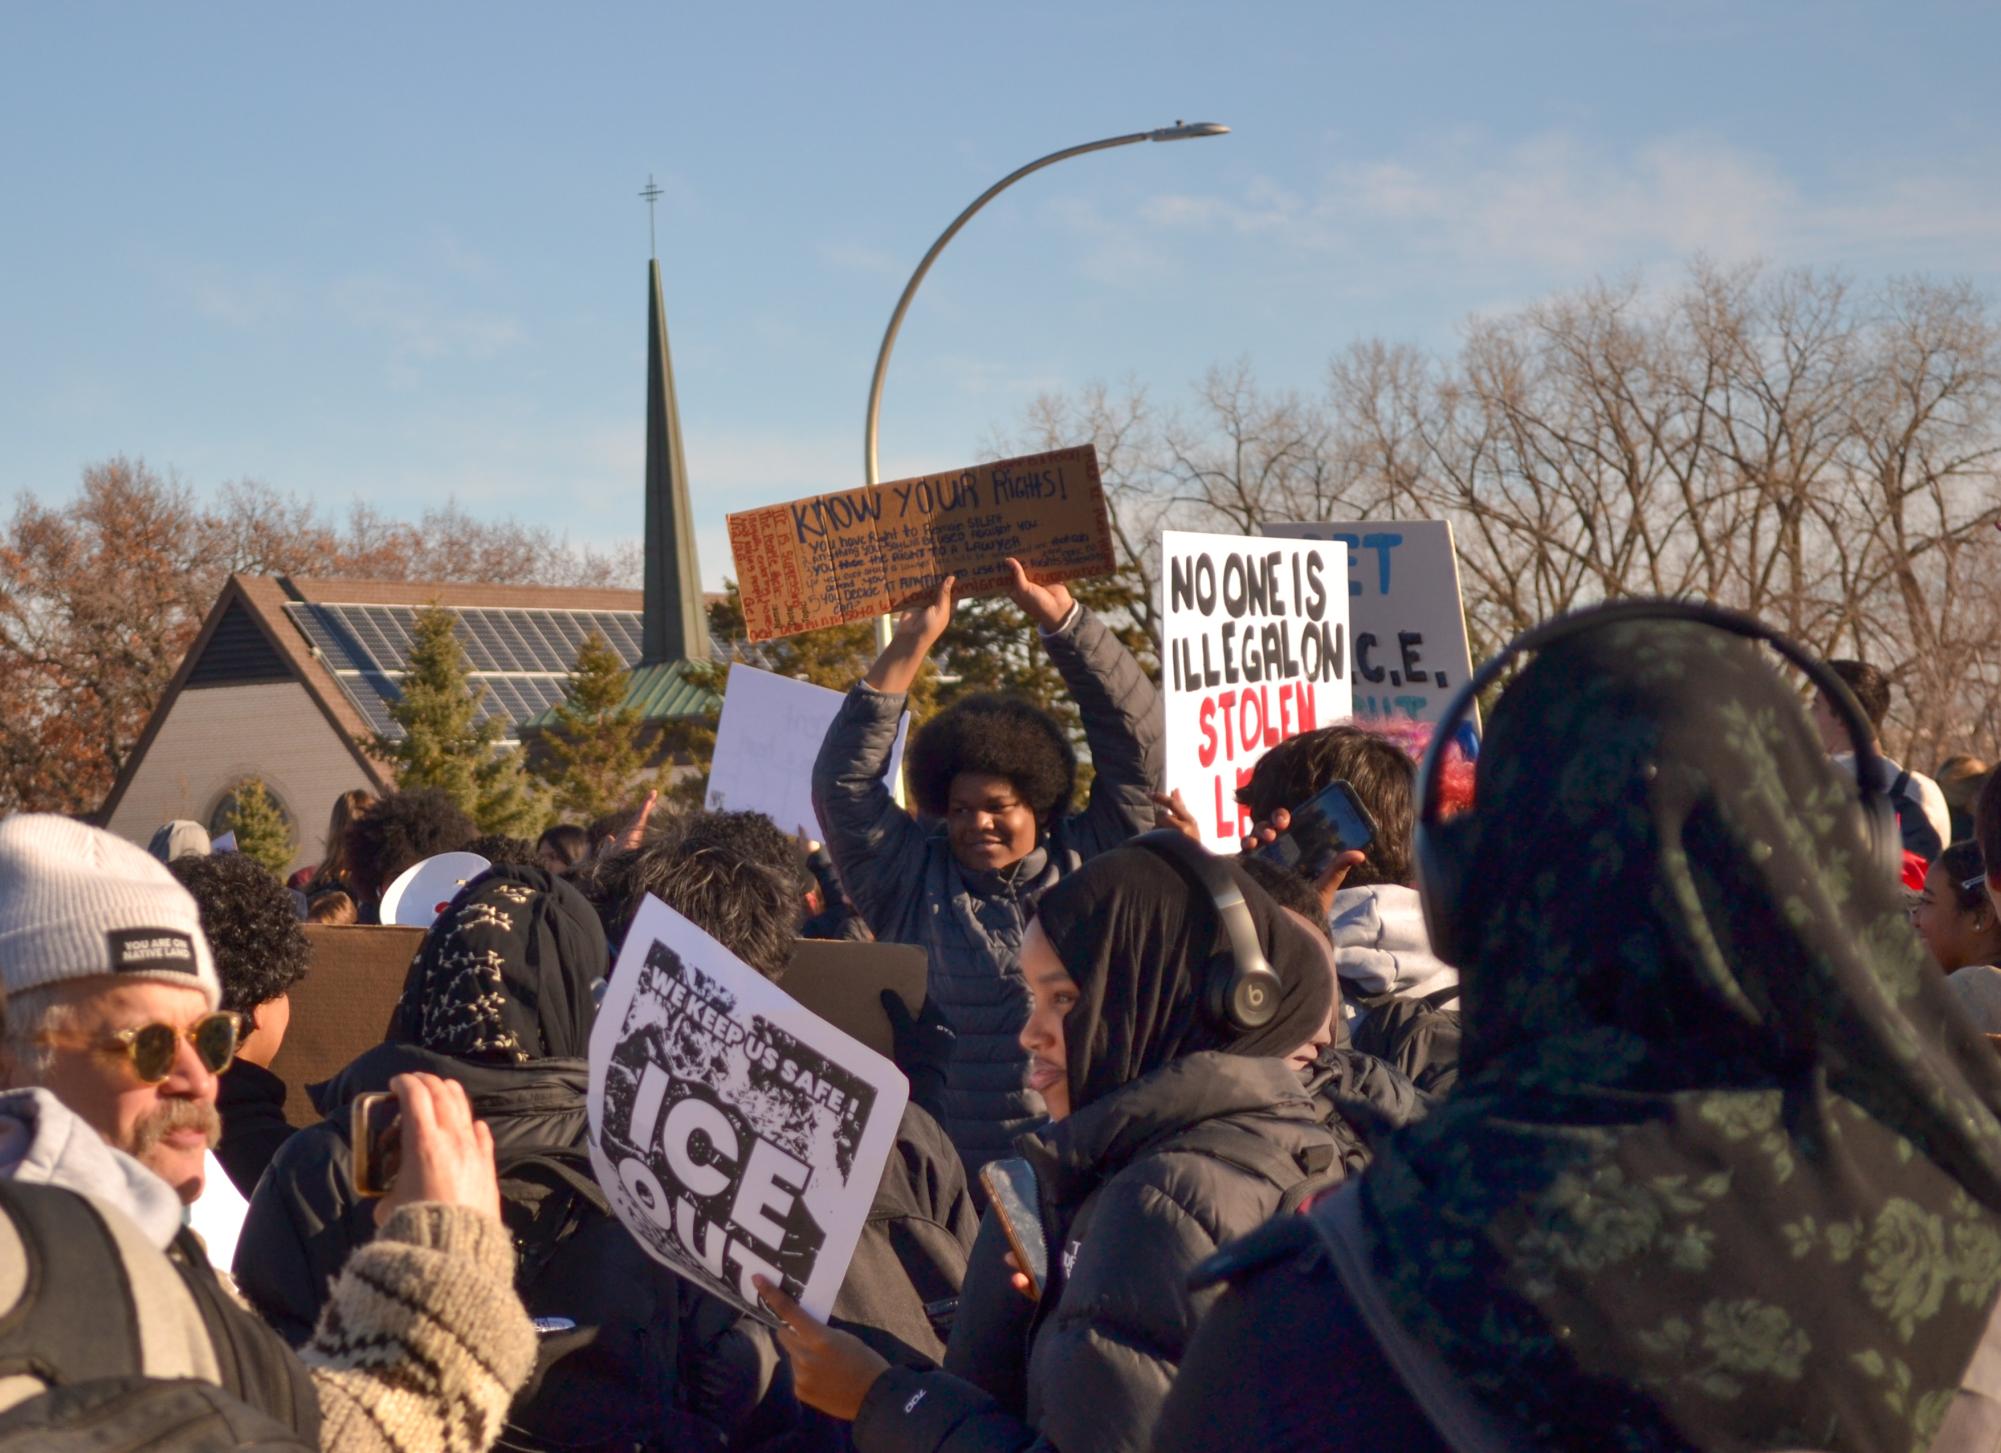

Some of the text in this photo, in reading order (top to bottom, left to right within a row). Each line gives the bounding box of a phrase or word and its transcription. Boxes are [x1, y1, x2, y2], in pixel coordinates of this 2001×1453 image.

[790, 492, 881, 543] KNOW
[893, 474, 979, 517] YOUR
[1172, 550, 1326, 621] NO ONE IS
[1320, 532, 1402, 595] ET
[1172, 619, 1344, 692] ILLEGAL ON
[1199, 682, 1316, 767] STOLEN
[122, 947, 191, 962] NATIVE LAND
[124, 938, 188, 950] YOU ARE ON
[650, 966, 687, 1010] WE
[688, 994, 743, 1047] KEEP
[745, 1038, 779, 1071] US
[629, 1061, 810, 1253] ICE
[618, 1157, 784, 1307] OUT
